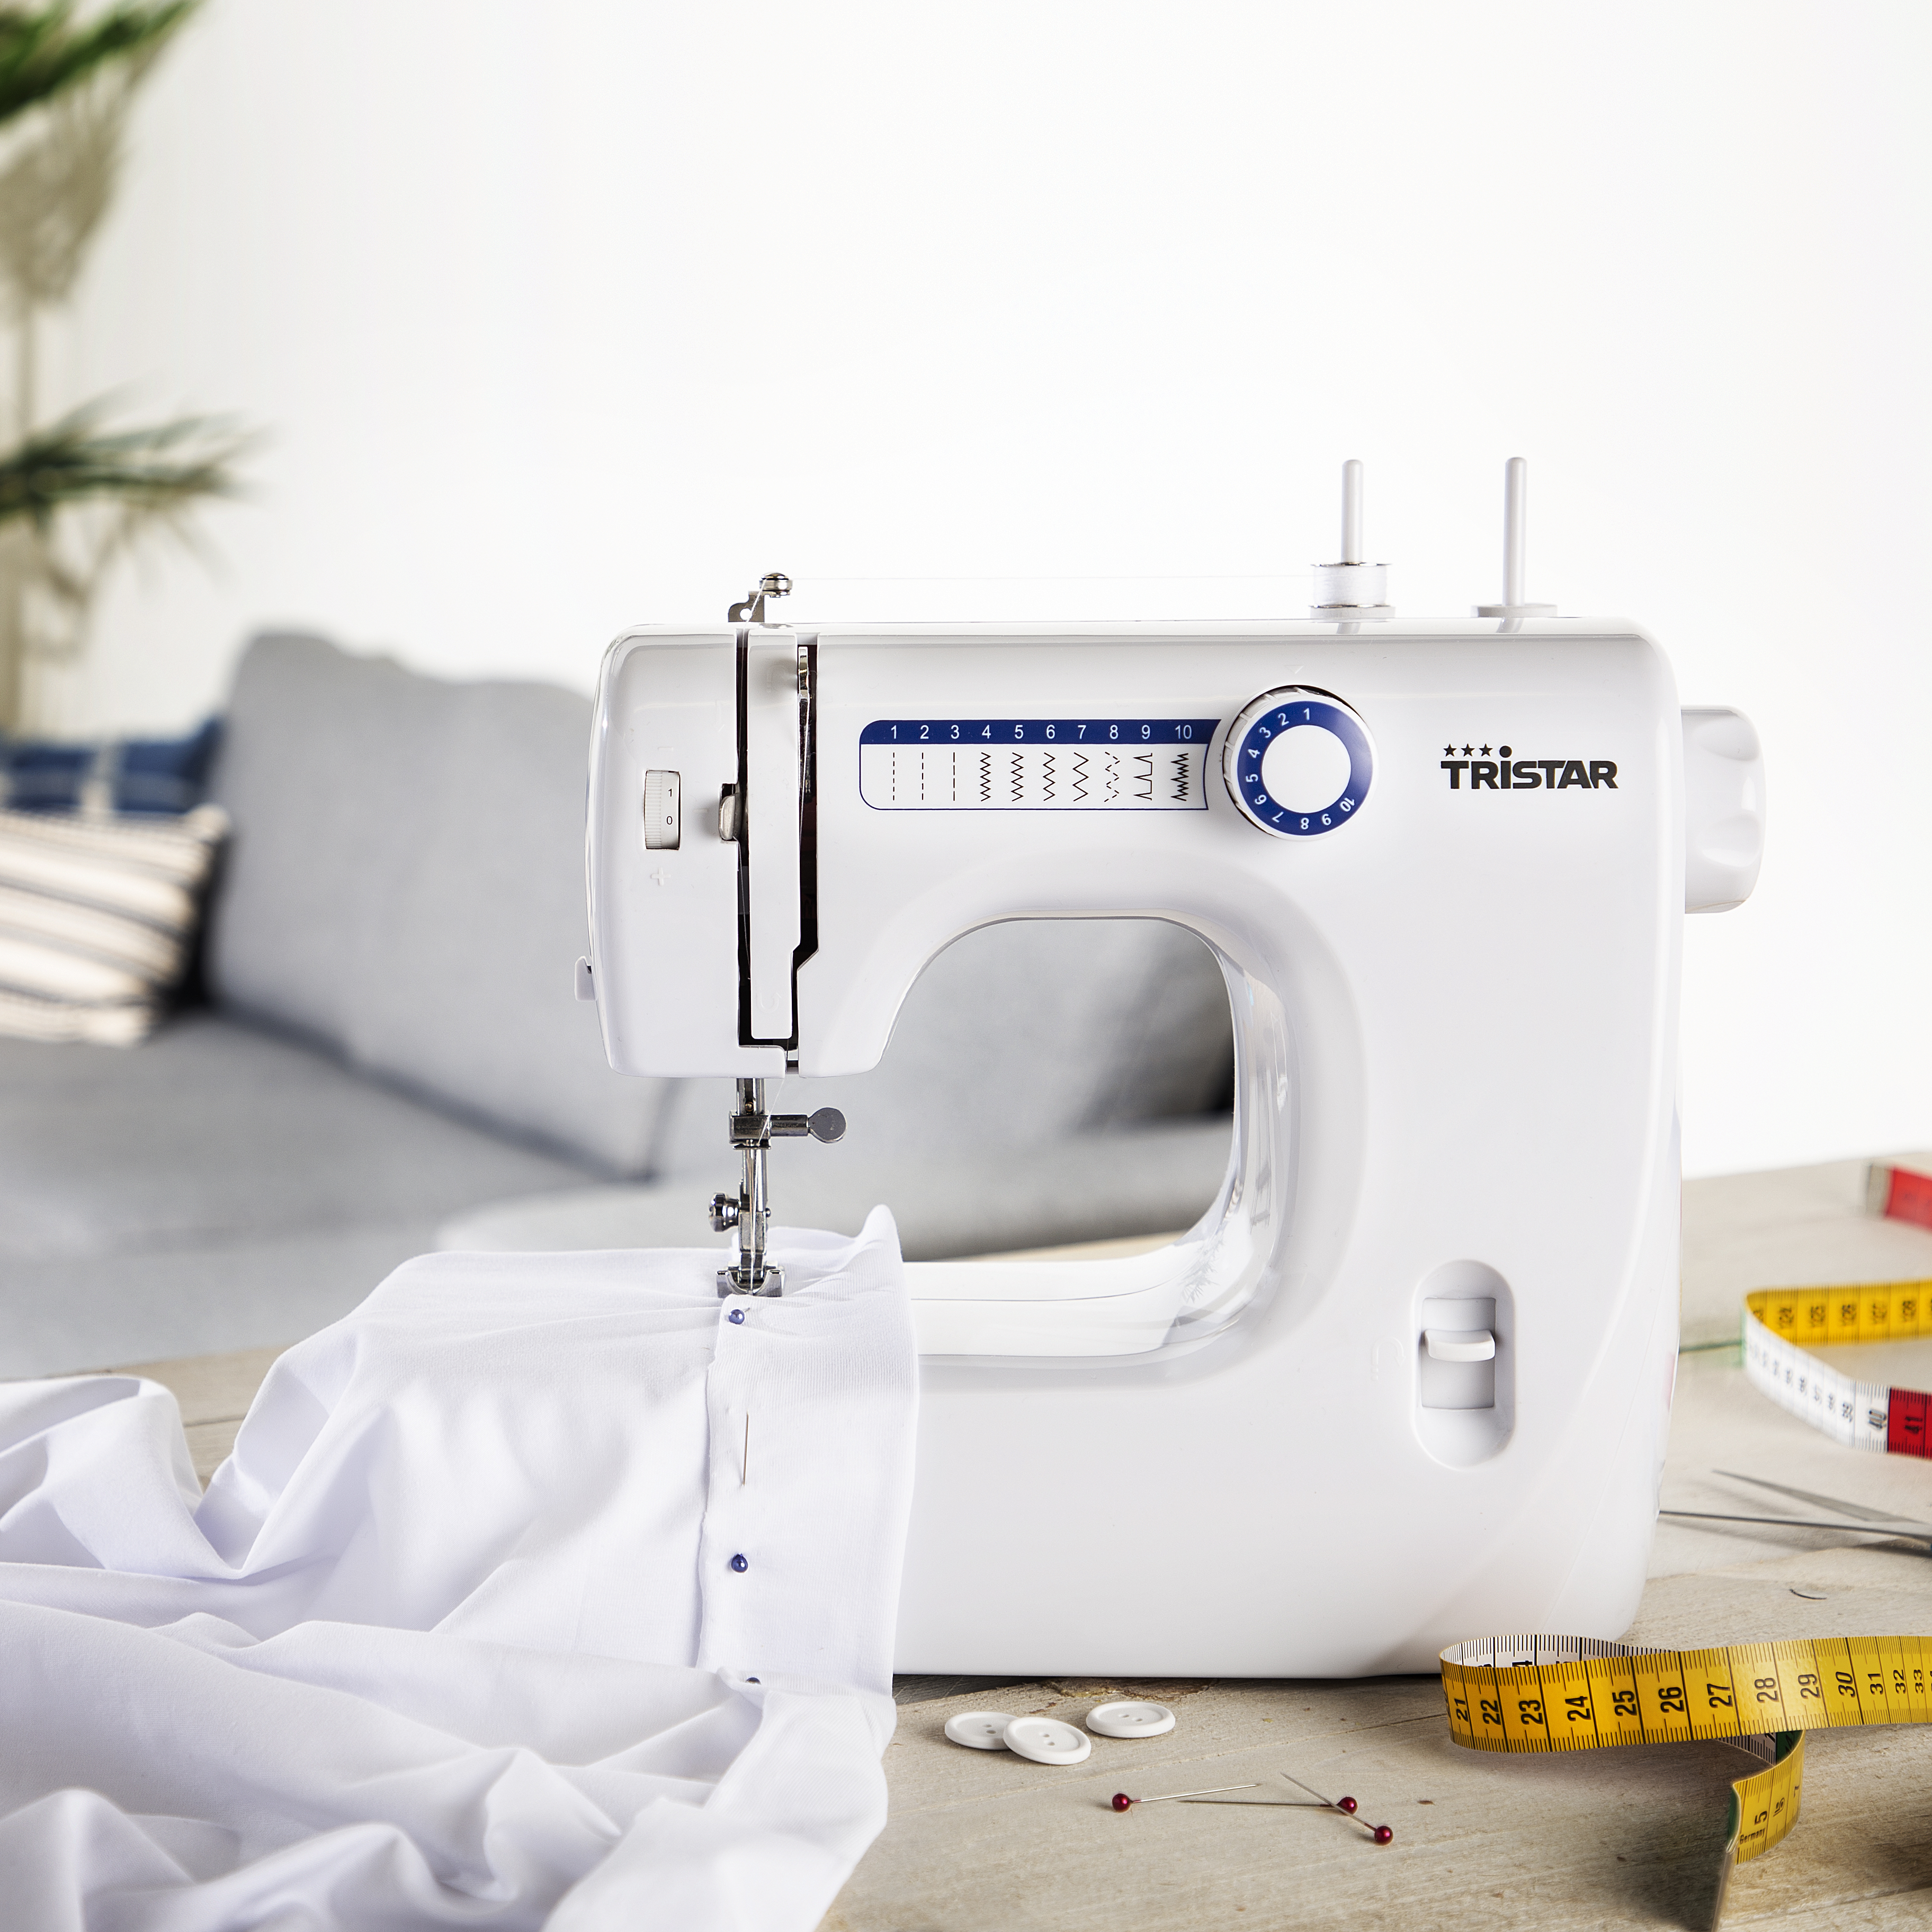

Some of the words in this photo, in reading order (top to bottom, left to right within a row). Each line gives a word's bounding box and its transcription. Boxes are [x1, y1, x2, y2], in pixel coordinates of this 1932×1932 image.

[1278, 713, 1289, 726] 2
[1304, 708, 1310, 720] 1
[891, 724, 897, 739] 1
[920, 724, 929, 739] 2
[951, 724, 960, 739] 3
[981, 724, 991, 739] 4
[1014, 724, 1024, 739] 5
[1046, 724, 1056, 739] 6
[1077, 724, 1087, 739] 7
[1110, 724, 1119, 739] 8
[1141, 724, 1150, 739] 9
[1175, 724, 1192, 739] 10
[1259, 727, 1271, 738] 3
[1248, 748, 1260, 758] 4
[1246, 773, 1258, 782] 5
[668, 788, 673, 797] 1
[1255, 794, 1267, 804] 6
[1340, 797, 1355, 812] 10
[666, 816, 673, 825] 0
[1272, 811, 1284, 822] 7
[1322, 813, 1331, 825] 9
[1301, 818, 1309, 829] 8
[1868, 1409, 1886, 1430] 40
[1904, 1416, 1922, 1434] 41
[1454, 1698, 1469, 1722] 21
[1480, 1700, 1501, 1725] 22
[1518, 1700, 1544, 1725] 23
[1565, 1696, 1591, 1722] 24
[1612, 1690, 1638, 1716] 25
[1658, 1686, 1685, 1713] 26
[1706, 1683, 1733, 1709] 27
[1754, 1677, 1779, 1703] 28
[1797, 1674, 1821, 1699] 29
[1835, 1671, 1855, 1698] 30
[1867, 1673, 1884, 1695] 31
[1893, 1669, 1906, 1694] 32
[1913, 1669, 1924, 1694] 33
[1754, 1810, 1768, 1826] 5
[1773, 1797, 1785, 1817] 6
[1740, 1827, 1766, 1845] Germany
